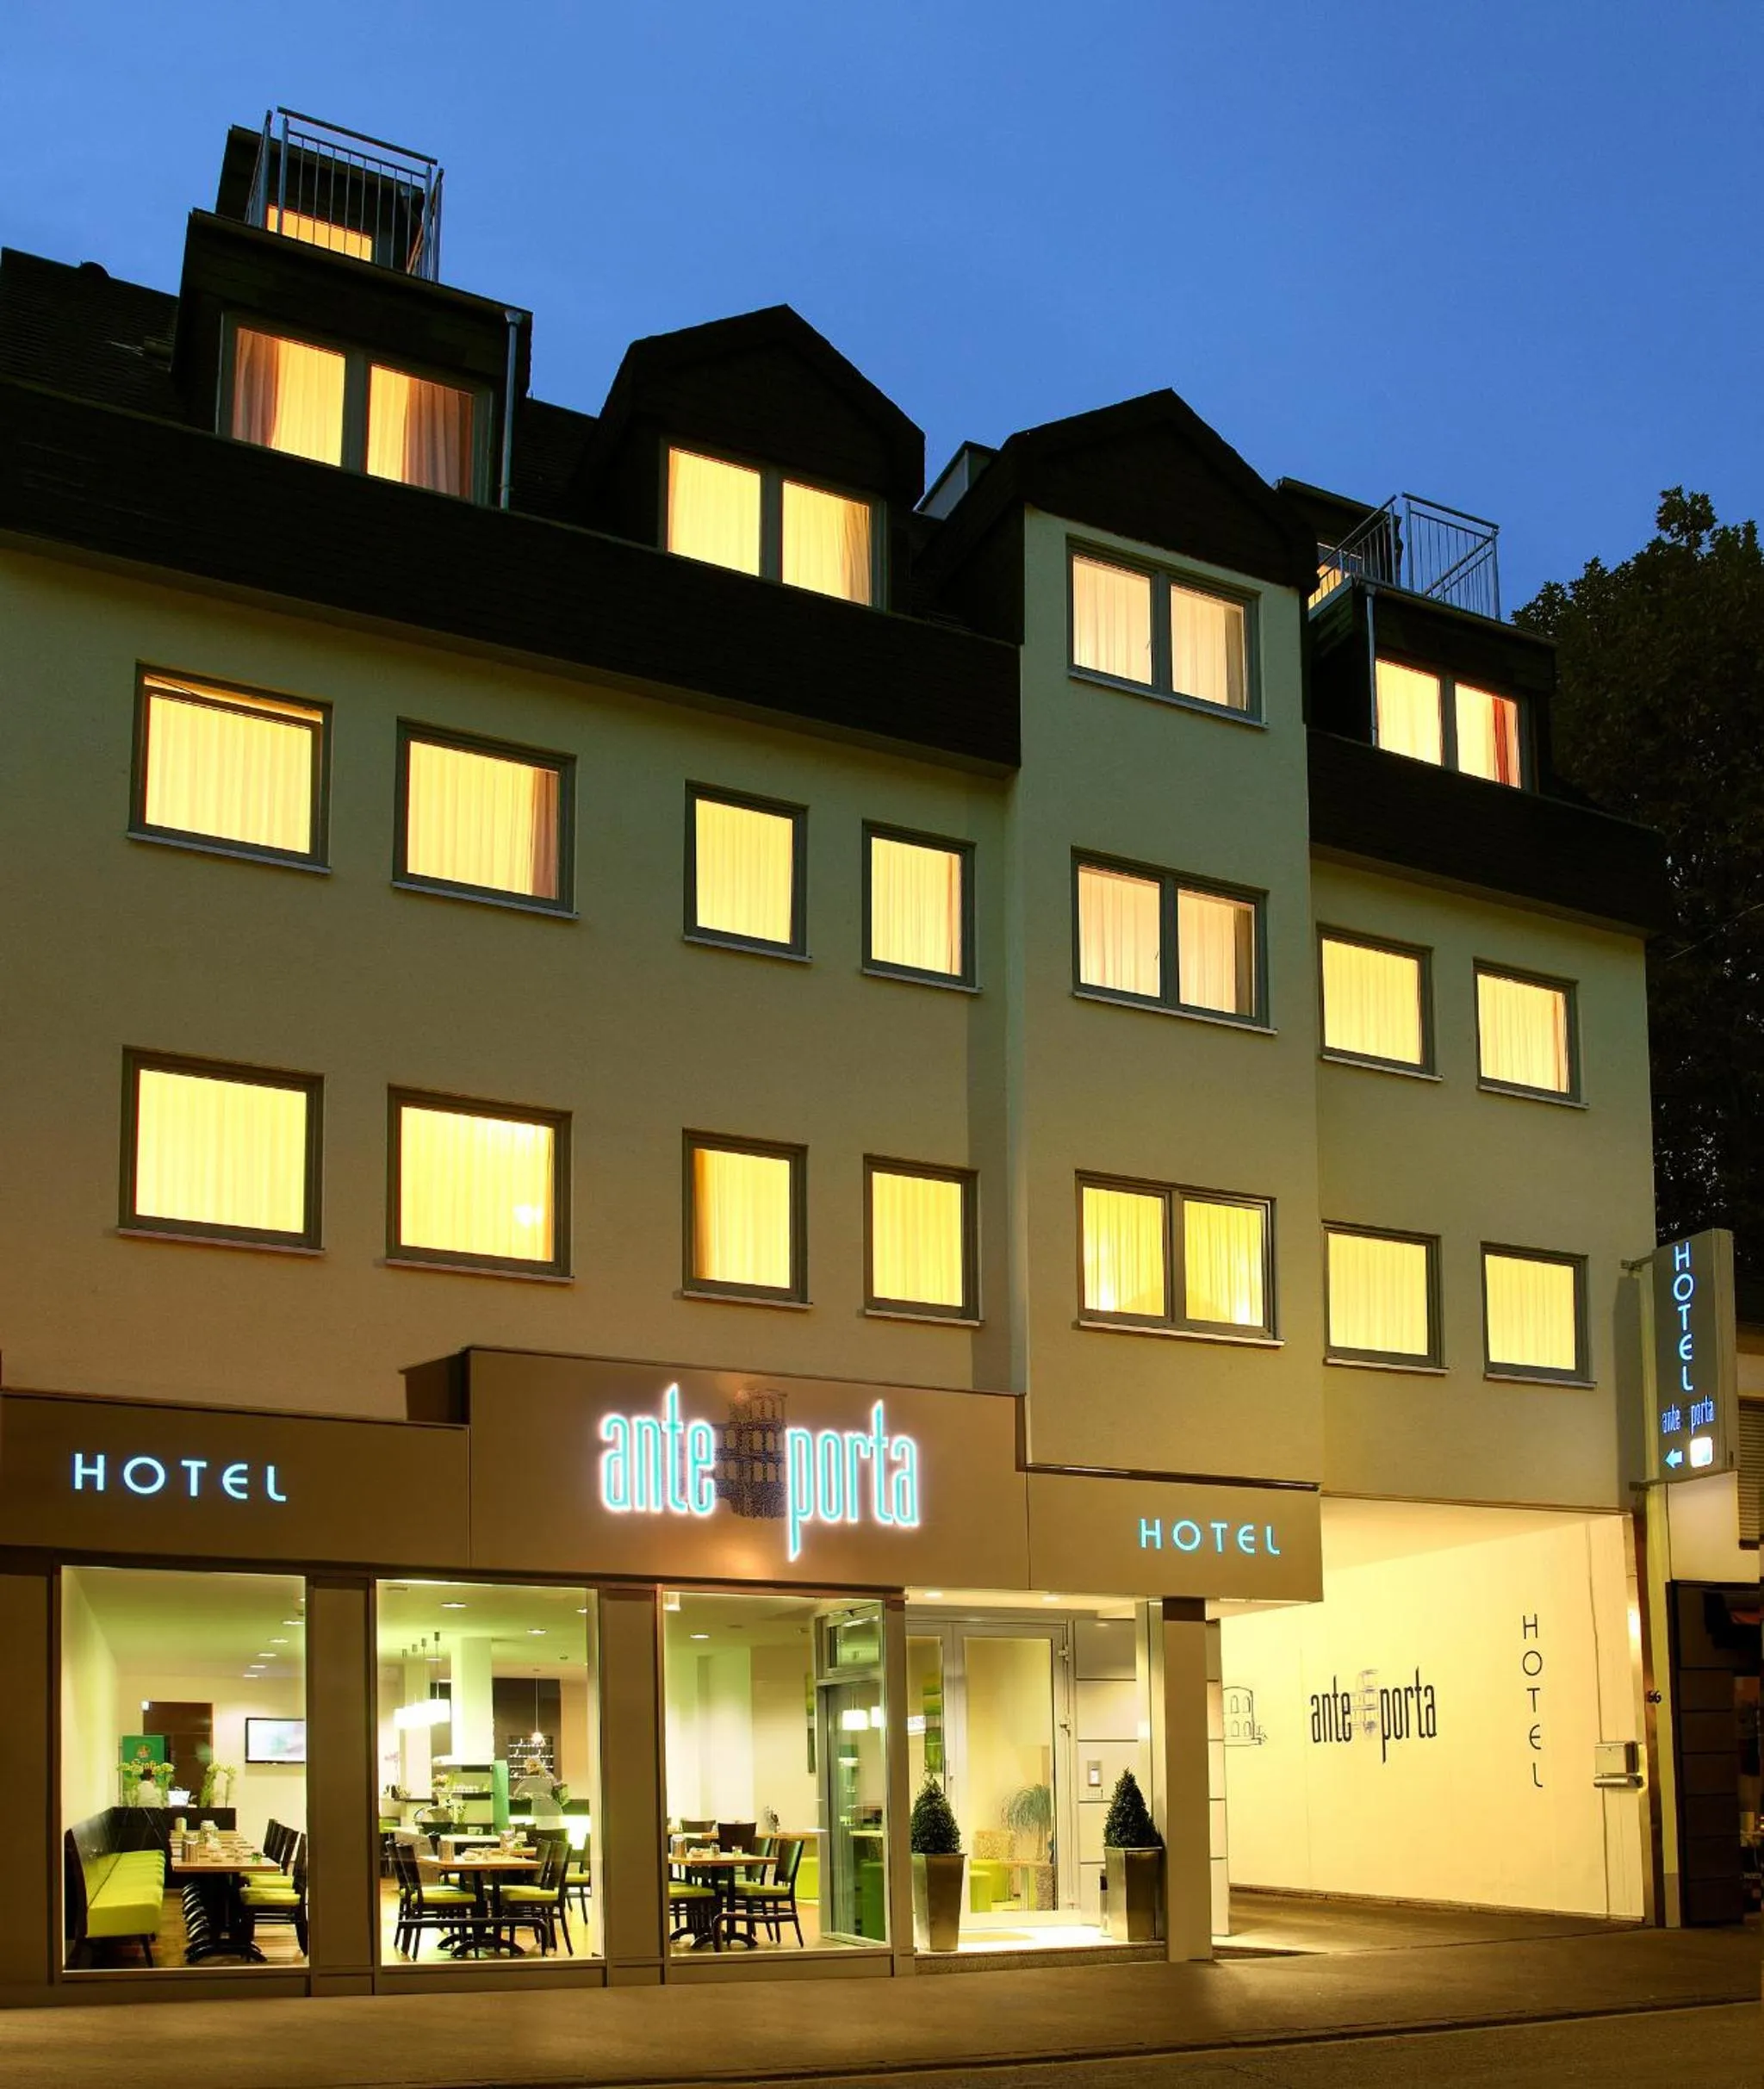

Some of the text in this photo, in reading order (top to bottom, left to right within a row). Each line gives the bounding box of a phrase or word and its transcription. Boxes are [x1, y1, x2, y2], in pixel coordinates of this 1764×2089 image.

[1673, 1240, 1694, 1391] HOTEL
[1661, 1395, 1715, 1436] ante porta
[72, 1452, 288, 1502] HOTEL
[600, 1382, 920, 1562] ante porta
[1139, 1518, 1282, 1556] HOTEL
[1310, 1665, 1438, 1765] ante porta
[1521, 1613, 1544, 1788] HOTEL
